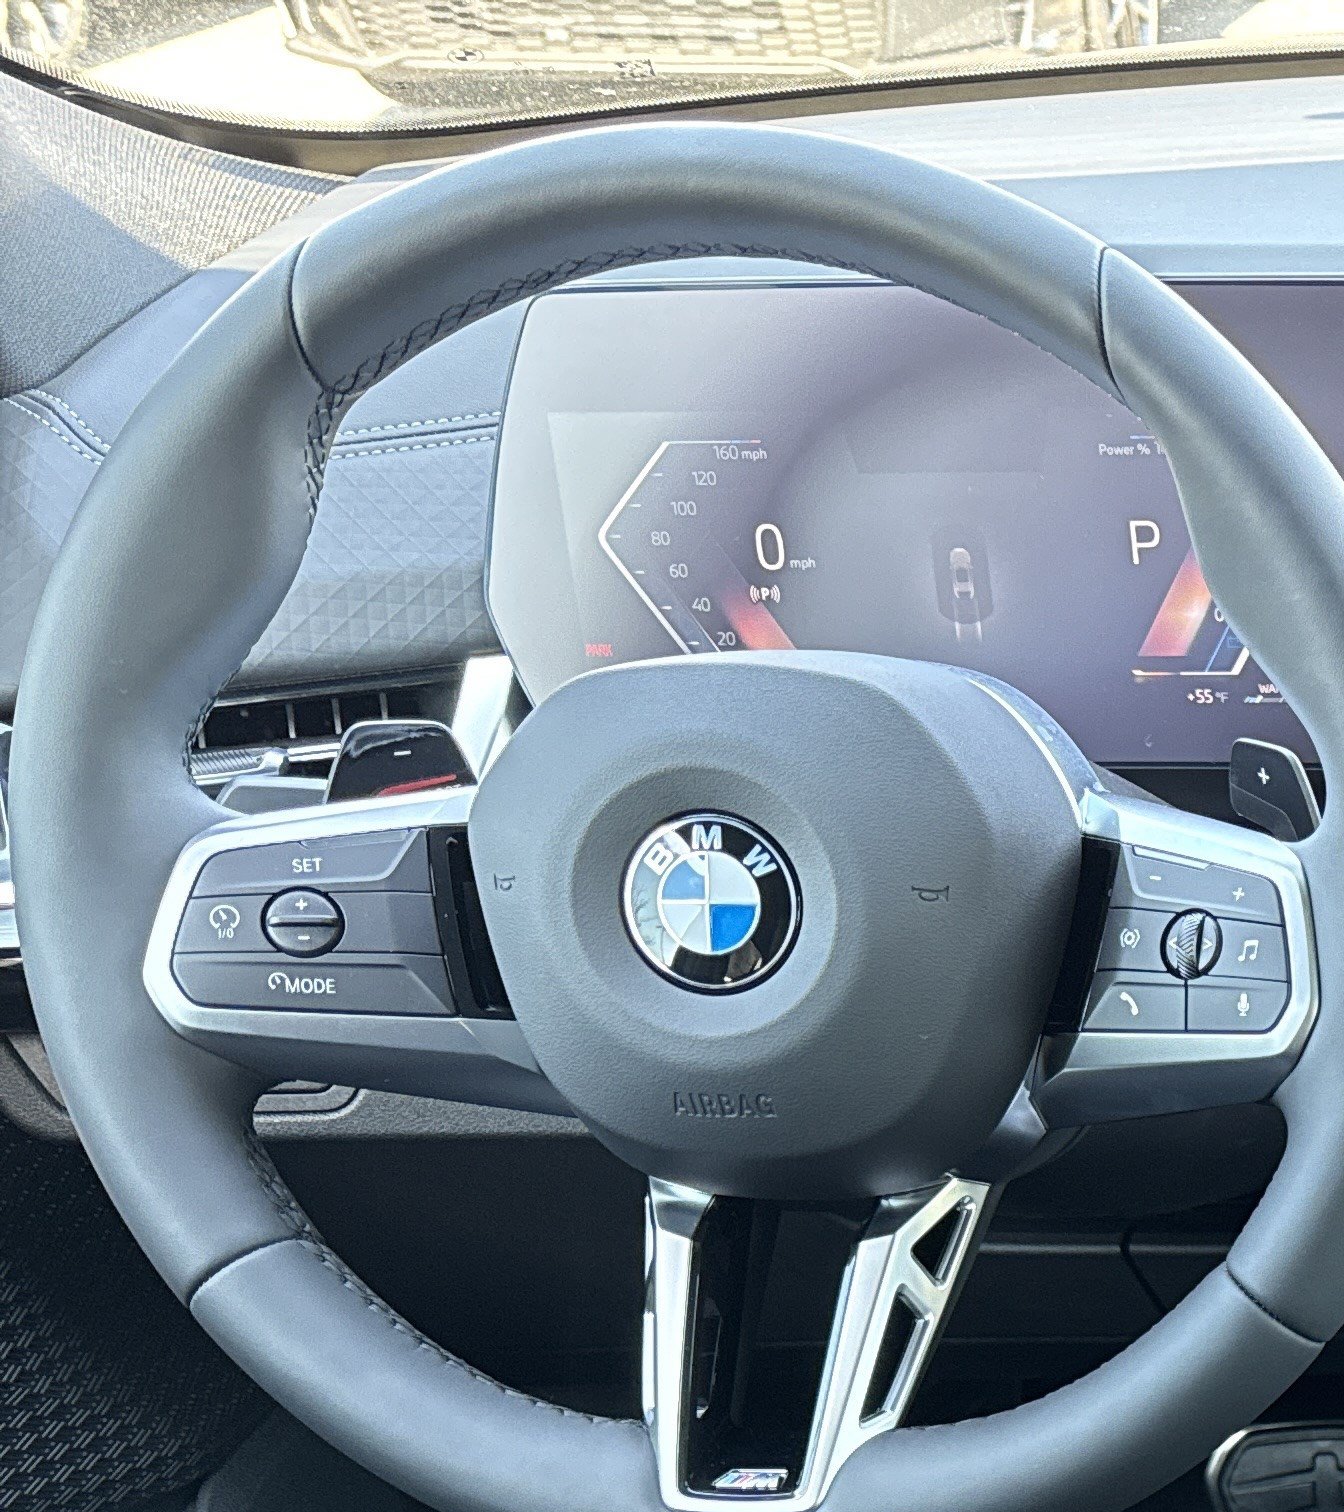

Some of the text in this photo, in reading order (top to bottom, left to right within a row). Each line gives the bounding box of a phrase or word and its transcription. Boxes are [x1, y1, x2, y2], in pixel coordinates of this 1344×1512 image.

[712, 445, 768, 461] 160 mph
[1098, 443, 1135, 456] Power
[1136, 443, 1151, 455] %
[692, 471, 717, 486] 120
[670, 502, 697, 516] 100
[651, 531, 671, 546] 80
[1129, 520, 1160, 565] P
[755, 523, 817, 571] 0 mph
[669, 563, 689, 578] 60
[691, 597, 711, 612] 40
[717, 631, 736, 646] 20
[643, 823, 778, 878] BMW
[291, 857, 323, 873] SET
[285, 978, 337, 994] MODE
[673, 1091, 778, 1118] AIRBAG
